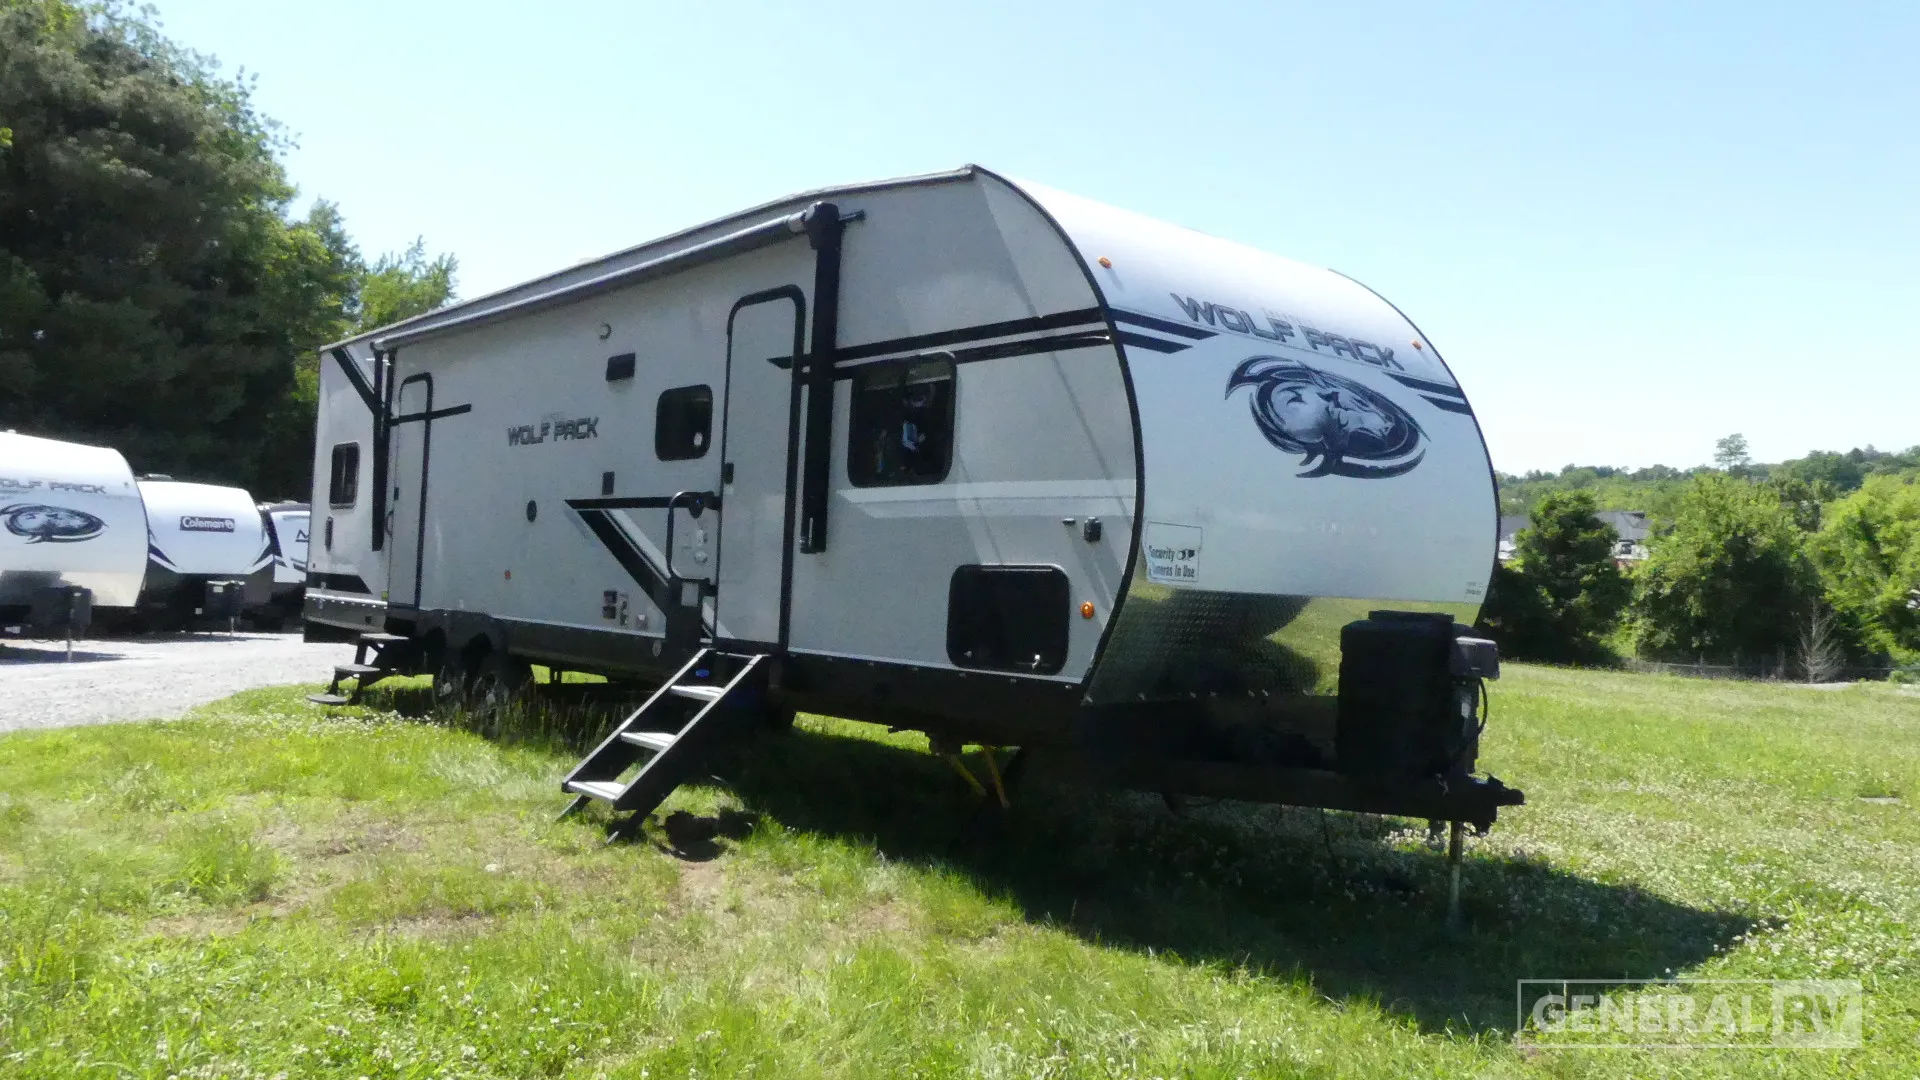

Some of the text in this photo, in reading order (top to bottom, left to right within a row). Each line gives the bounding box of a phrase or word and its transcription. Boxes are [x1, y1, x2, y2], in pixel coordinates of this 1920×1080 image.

[1170, 291, 1294, 343] WOLF
[1299, 324, 1406, 371] PACK
[507, 416, 599, 447] WOLF PACK
[0, 477, 107, 494] OLF PACK
[182, 516, 225, 529] Coleman
